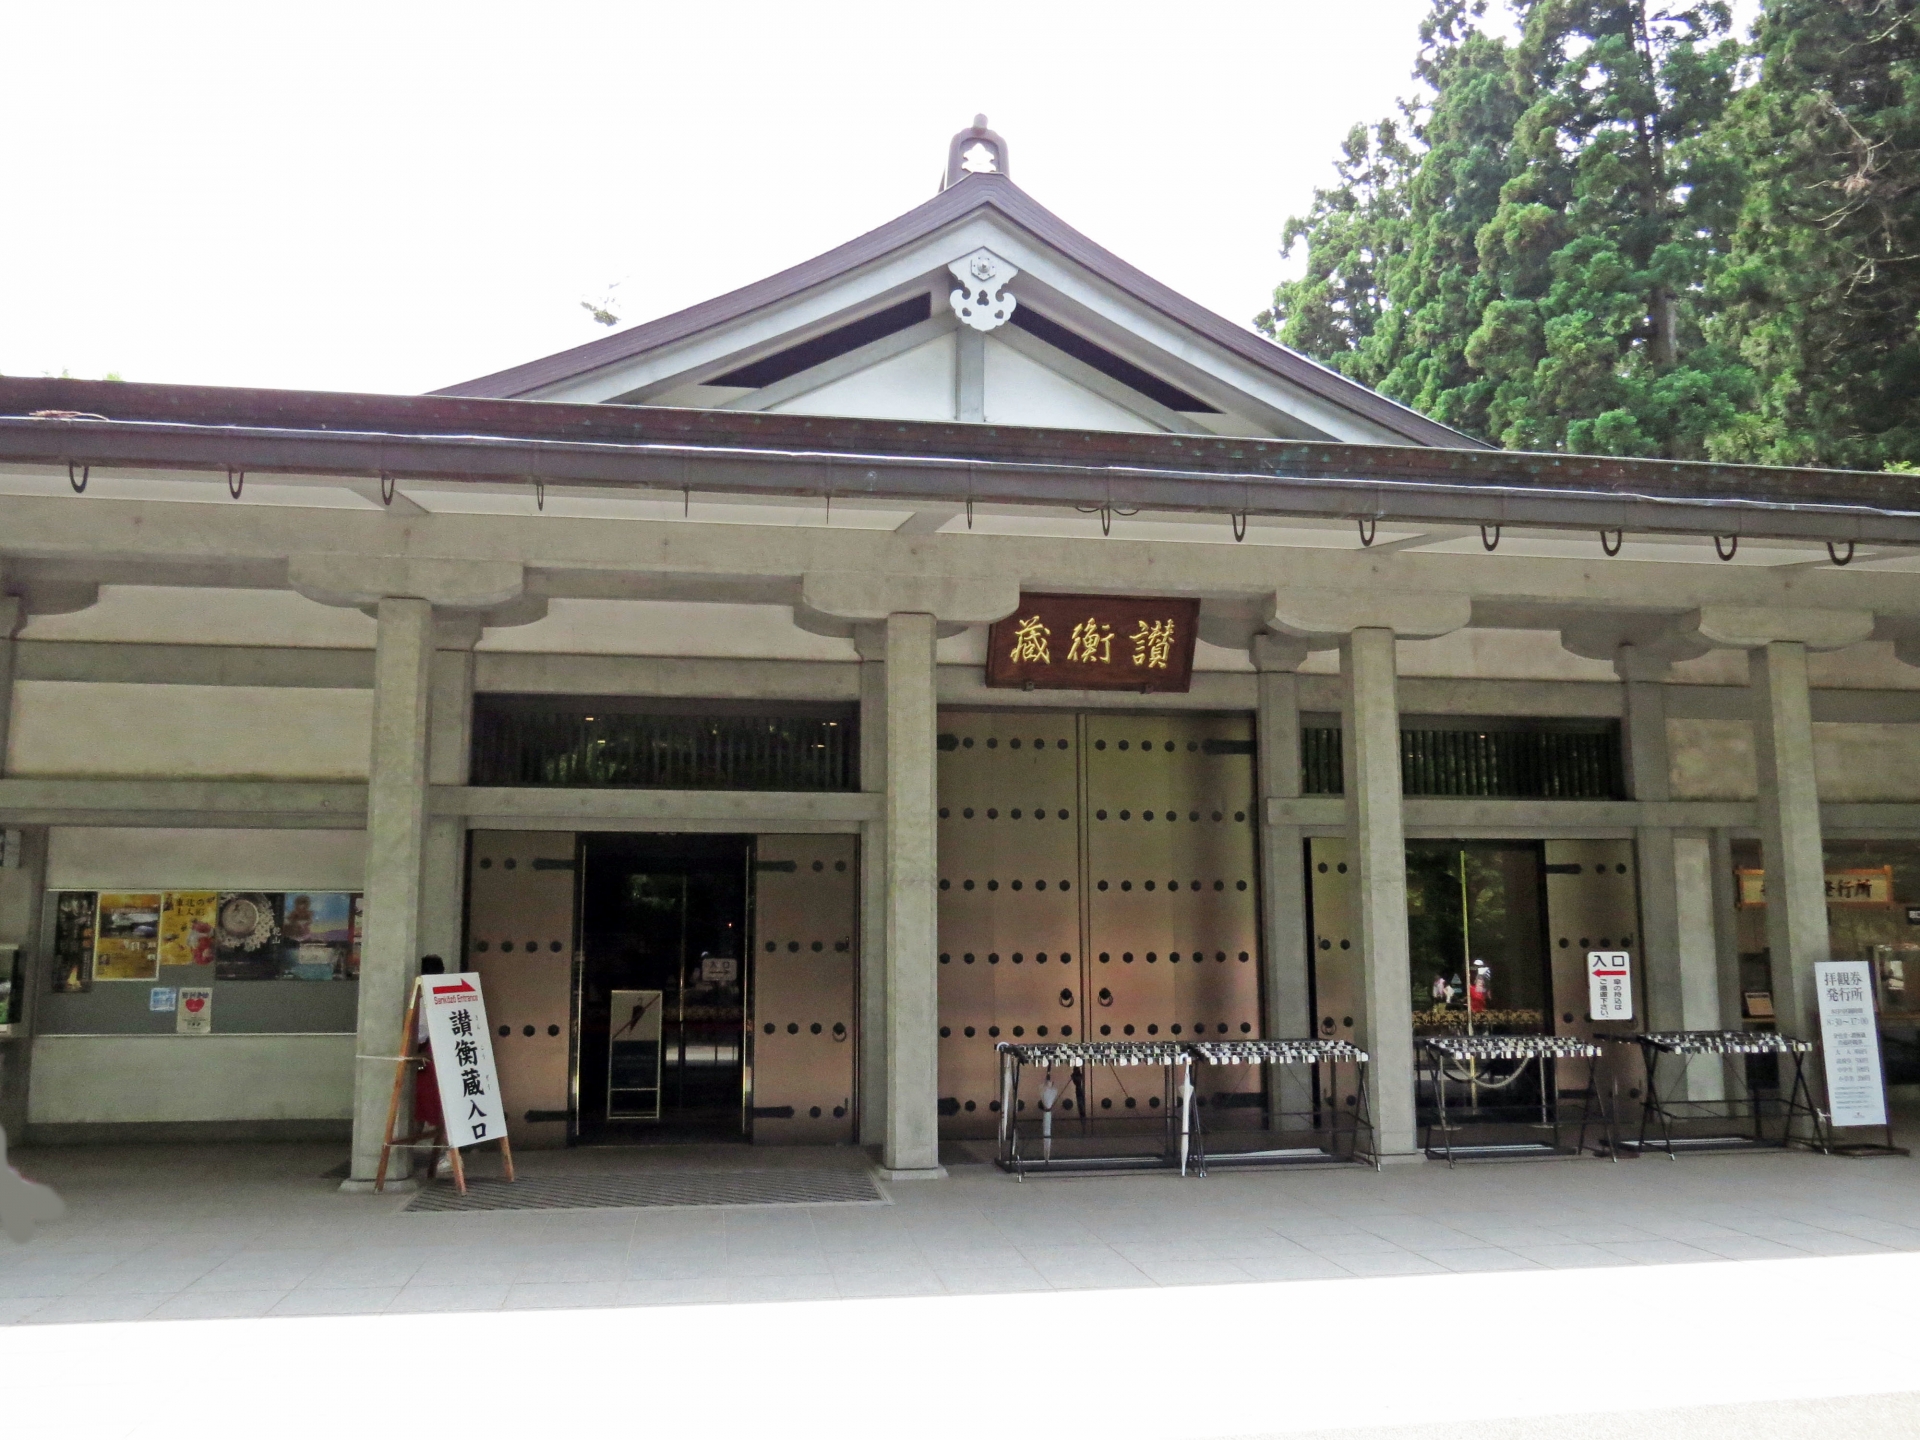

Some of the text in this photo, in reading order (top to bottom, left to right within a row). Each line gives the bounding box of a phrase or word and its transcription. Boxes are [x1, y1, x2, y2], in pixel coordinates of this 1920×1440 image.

[1592, 954, 1625, 968] 入口
[1824, 971, 1863, 986] 拝観券
[456, 994, 479, 1003] Entrance
[1826, 987, 1864, 1002] 発行所
